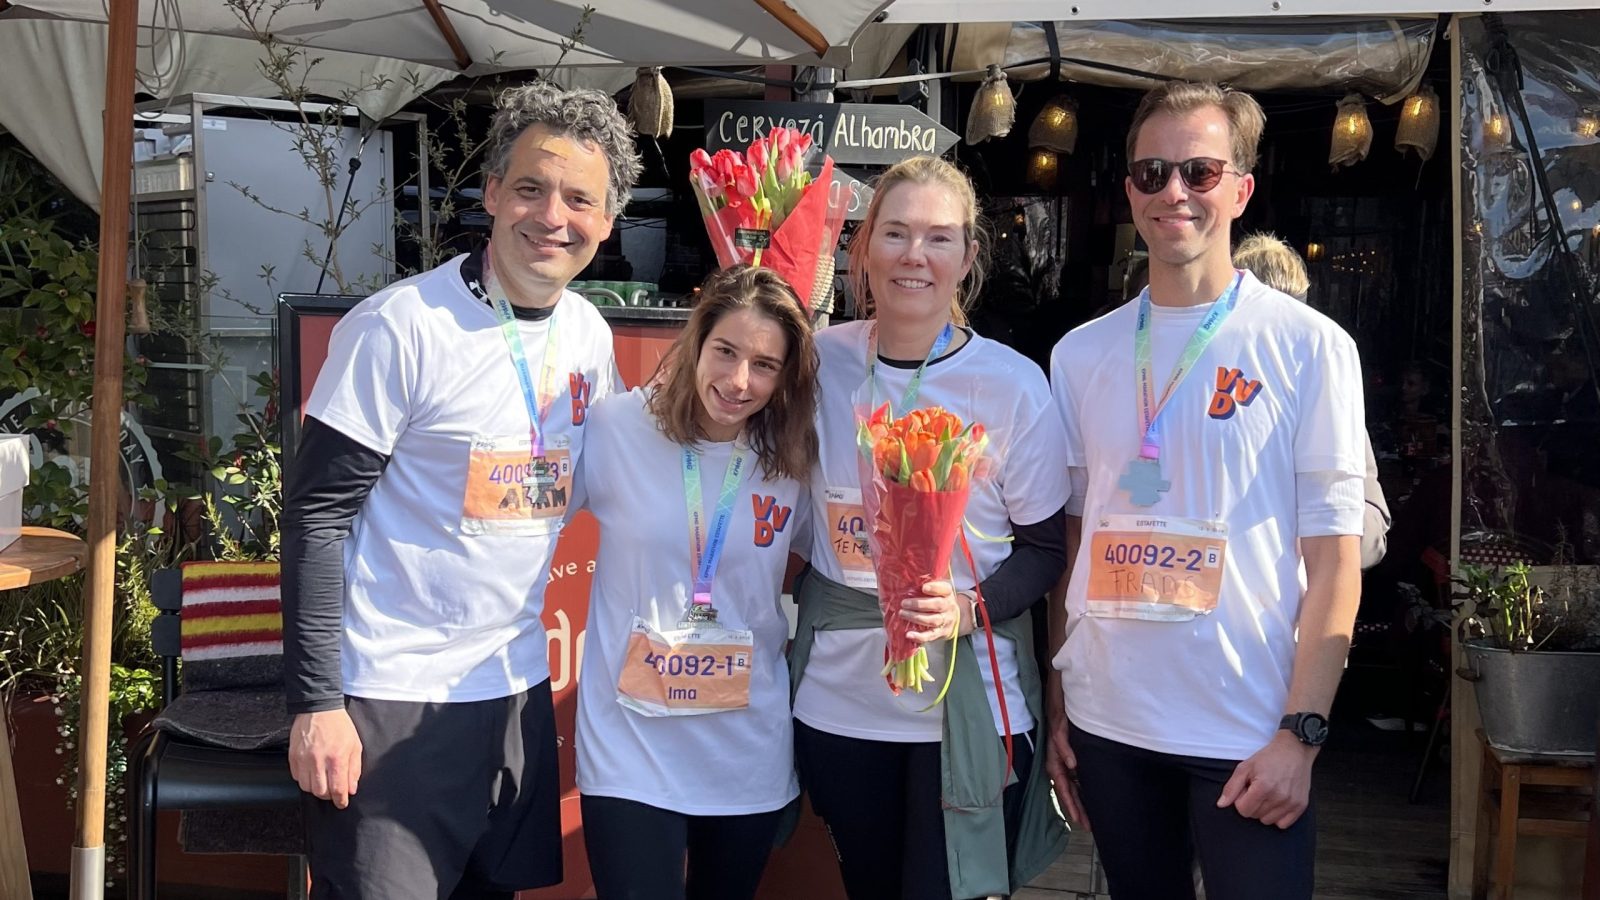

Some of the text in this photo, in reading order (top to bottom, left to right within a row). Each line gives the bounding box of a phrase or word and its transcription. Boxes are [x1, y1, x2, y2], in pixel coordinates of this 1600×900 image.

[1203, 311, 1219, 331] KPMG
[1104, 543, 1217, 572] 40092-2 B
[644, 651, 745, 676] 40092-1 B
[668, 686, 697, 700] Ima
